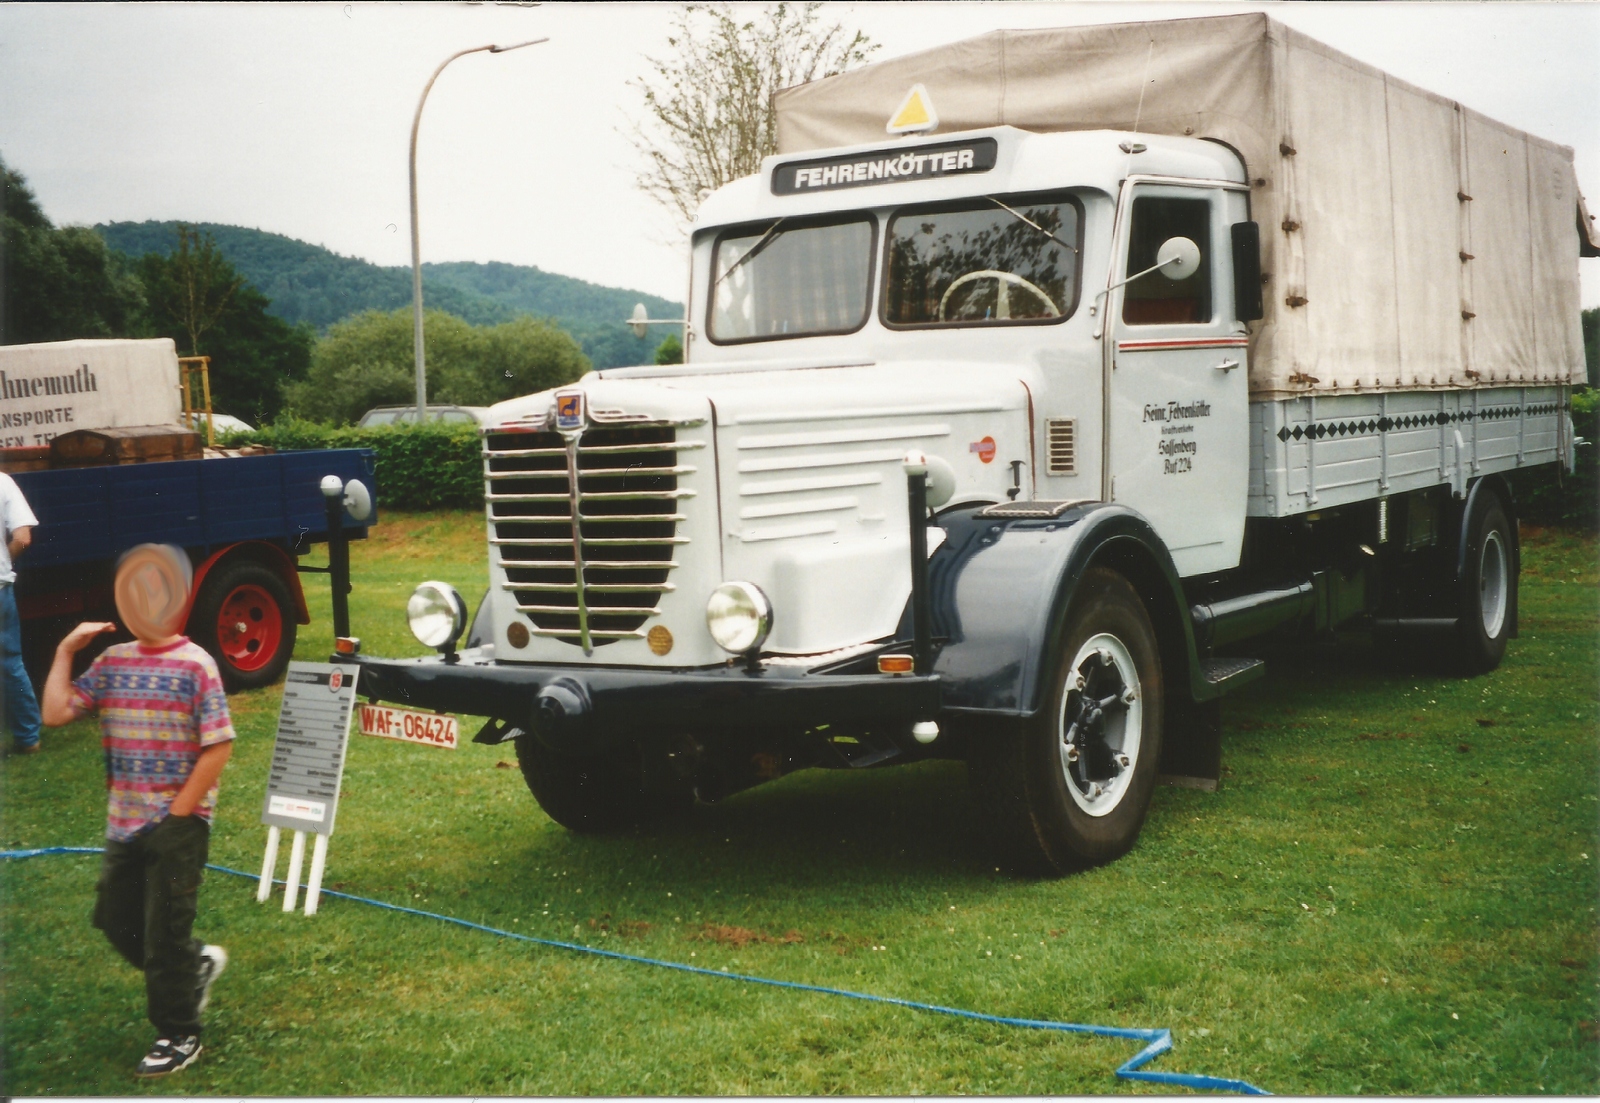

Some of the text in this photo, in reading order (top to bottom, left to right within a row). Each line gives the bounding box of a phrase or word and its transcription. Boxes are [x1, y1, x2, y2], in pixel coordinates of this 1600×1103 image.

[795, 149, 974, 189] FEHRENKÖTTER
[0, 363, 98, 399] hnemuth
[0, 406, 74, 429] NSPORTE
[1178, 457, 1192, 473] 224
[331, 673, 342, 688] 15
